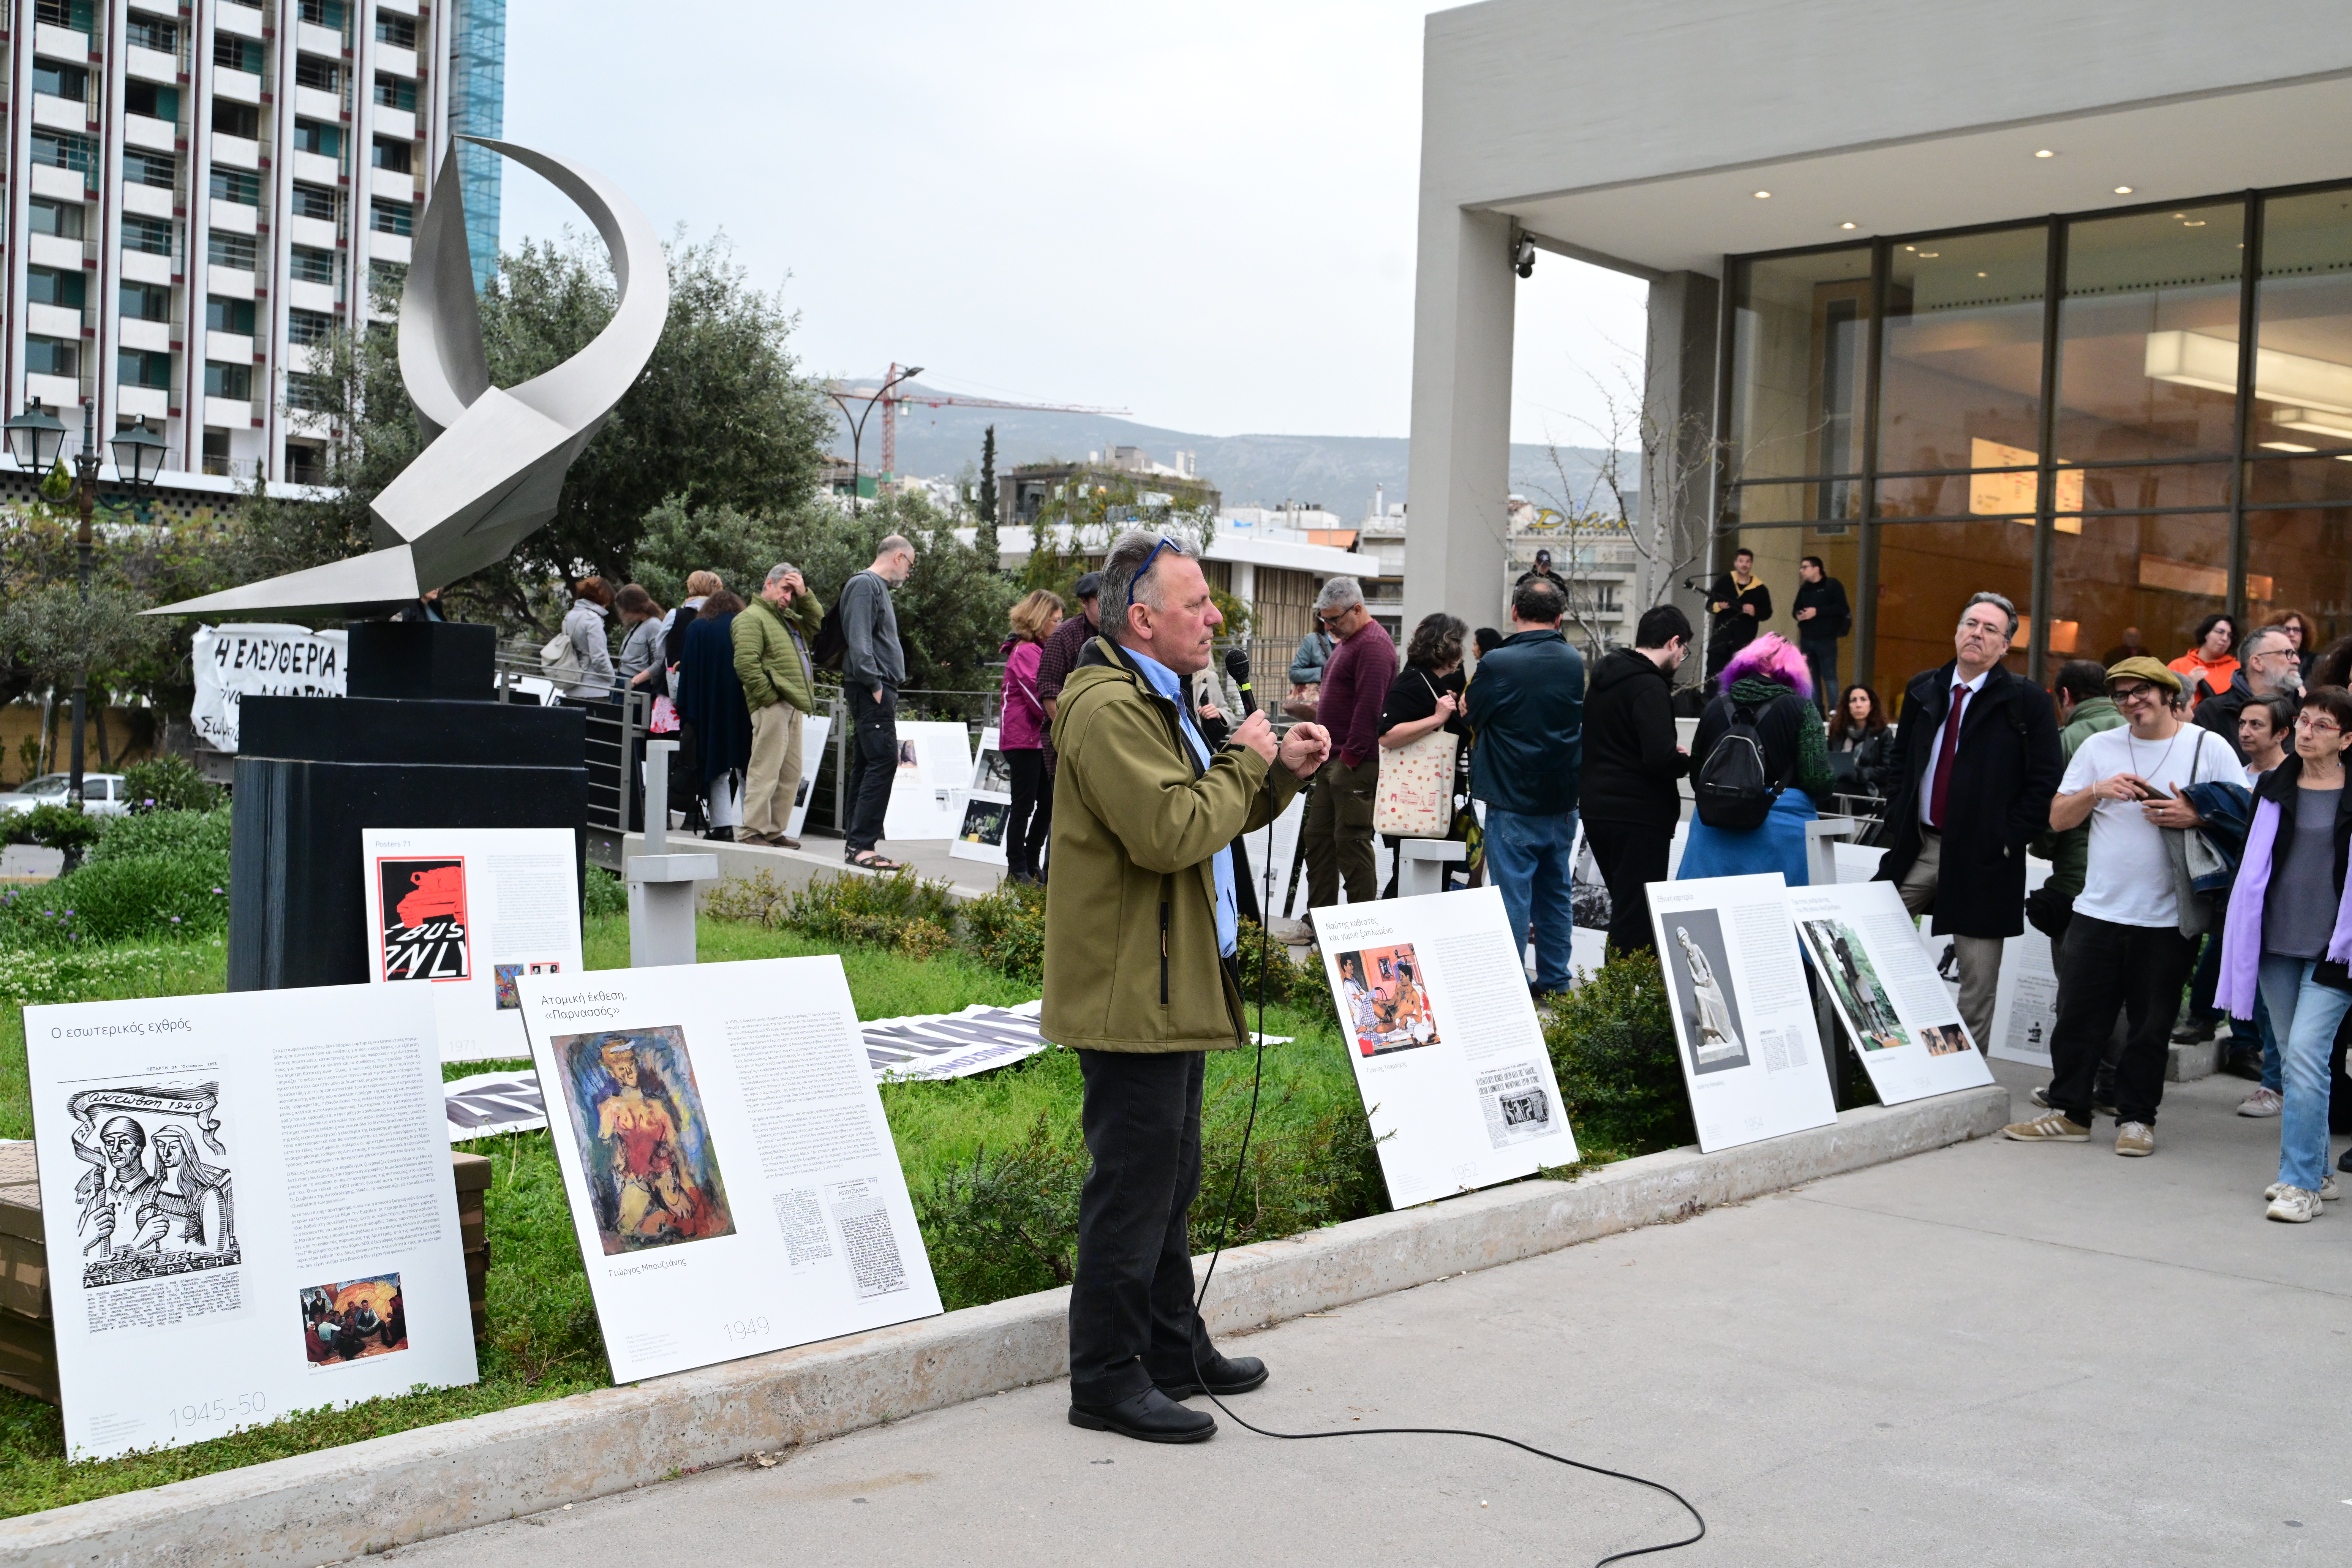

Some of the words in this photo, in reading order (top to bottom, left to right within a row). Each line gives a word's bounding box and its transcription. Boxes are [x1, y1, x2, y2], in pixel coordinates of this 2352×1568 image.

[234, 639, 335, 678] ΕΛΕΥΘΕΡΙΑ
[396, 922, 464, 941] BUS
[1325, 921, 1350, 930] Ναύτης
[1350, 917, 1378, 927] καθιστός
[1340, 930, 1359, 942] γυμνό
[1359, 926, 1393, 939] ξαπλωμένο
[542, 992, 585, 1006] Ατομική
[588, 991, 627, 1002] έκθεση,
[545, 1005, 620, 1021] «Παρνασσός»
[52, 1027, 61, 1038] Ο
[66, 1021, 145, 1038] εσωτερικός
[149, 1018, 192, 1034] εχθρός
[449, 1039, 476, 1053] 1971
[1384, 1062, 1407, 1070] Τσαρούχης
[168, 1101, 203, 1110] 1940
[78, 1123, 90, 1140] 28
[1744, 1116, 1764, 1132] 1954
[1451, 1162, 1479, 1181] 1952
[838, 1187, 869, 1196] ΜΠΟΥΖΙΑΝΗΣ
[609, 1266, 641, 1277] Γιώργος
[642, 1258, 687, 1271] Μπουζιάνης
[723, 1316, 769, 1341] 1949
[169, 1391, 266, 1429] 1945-50
